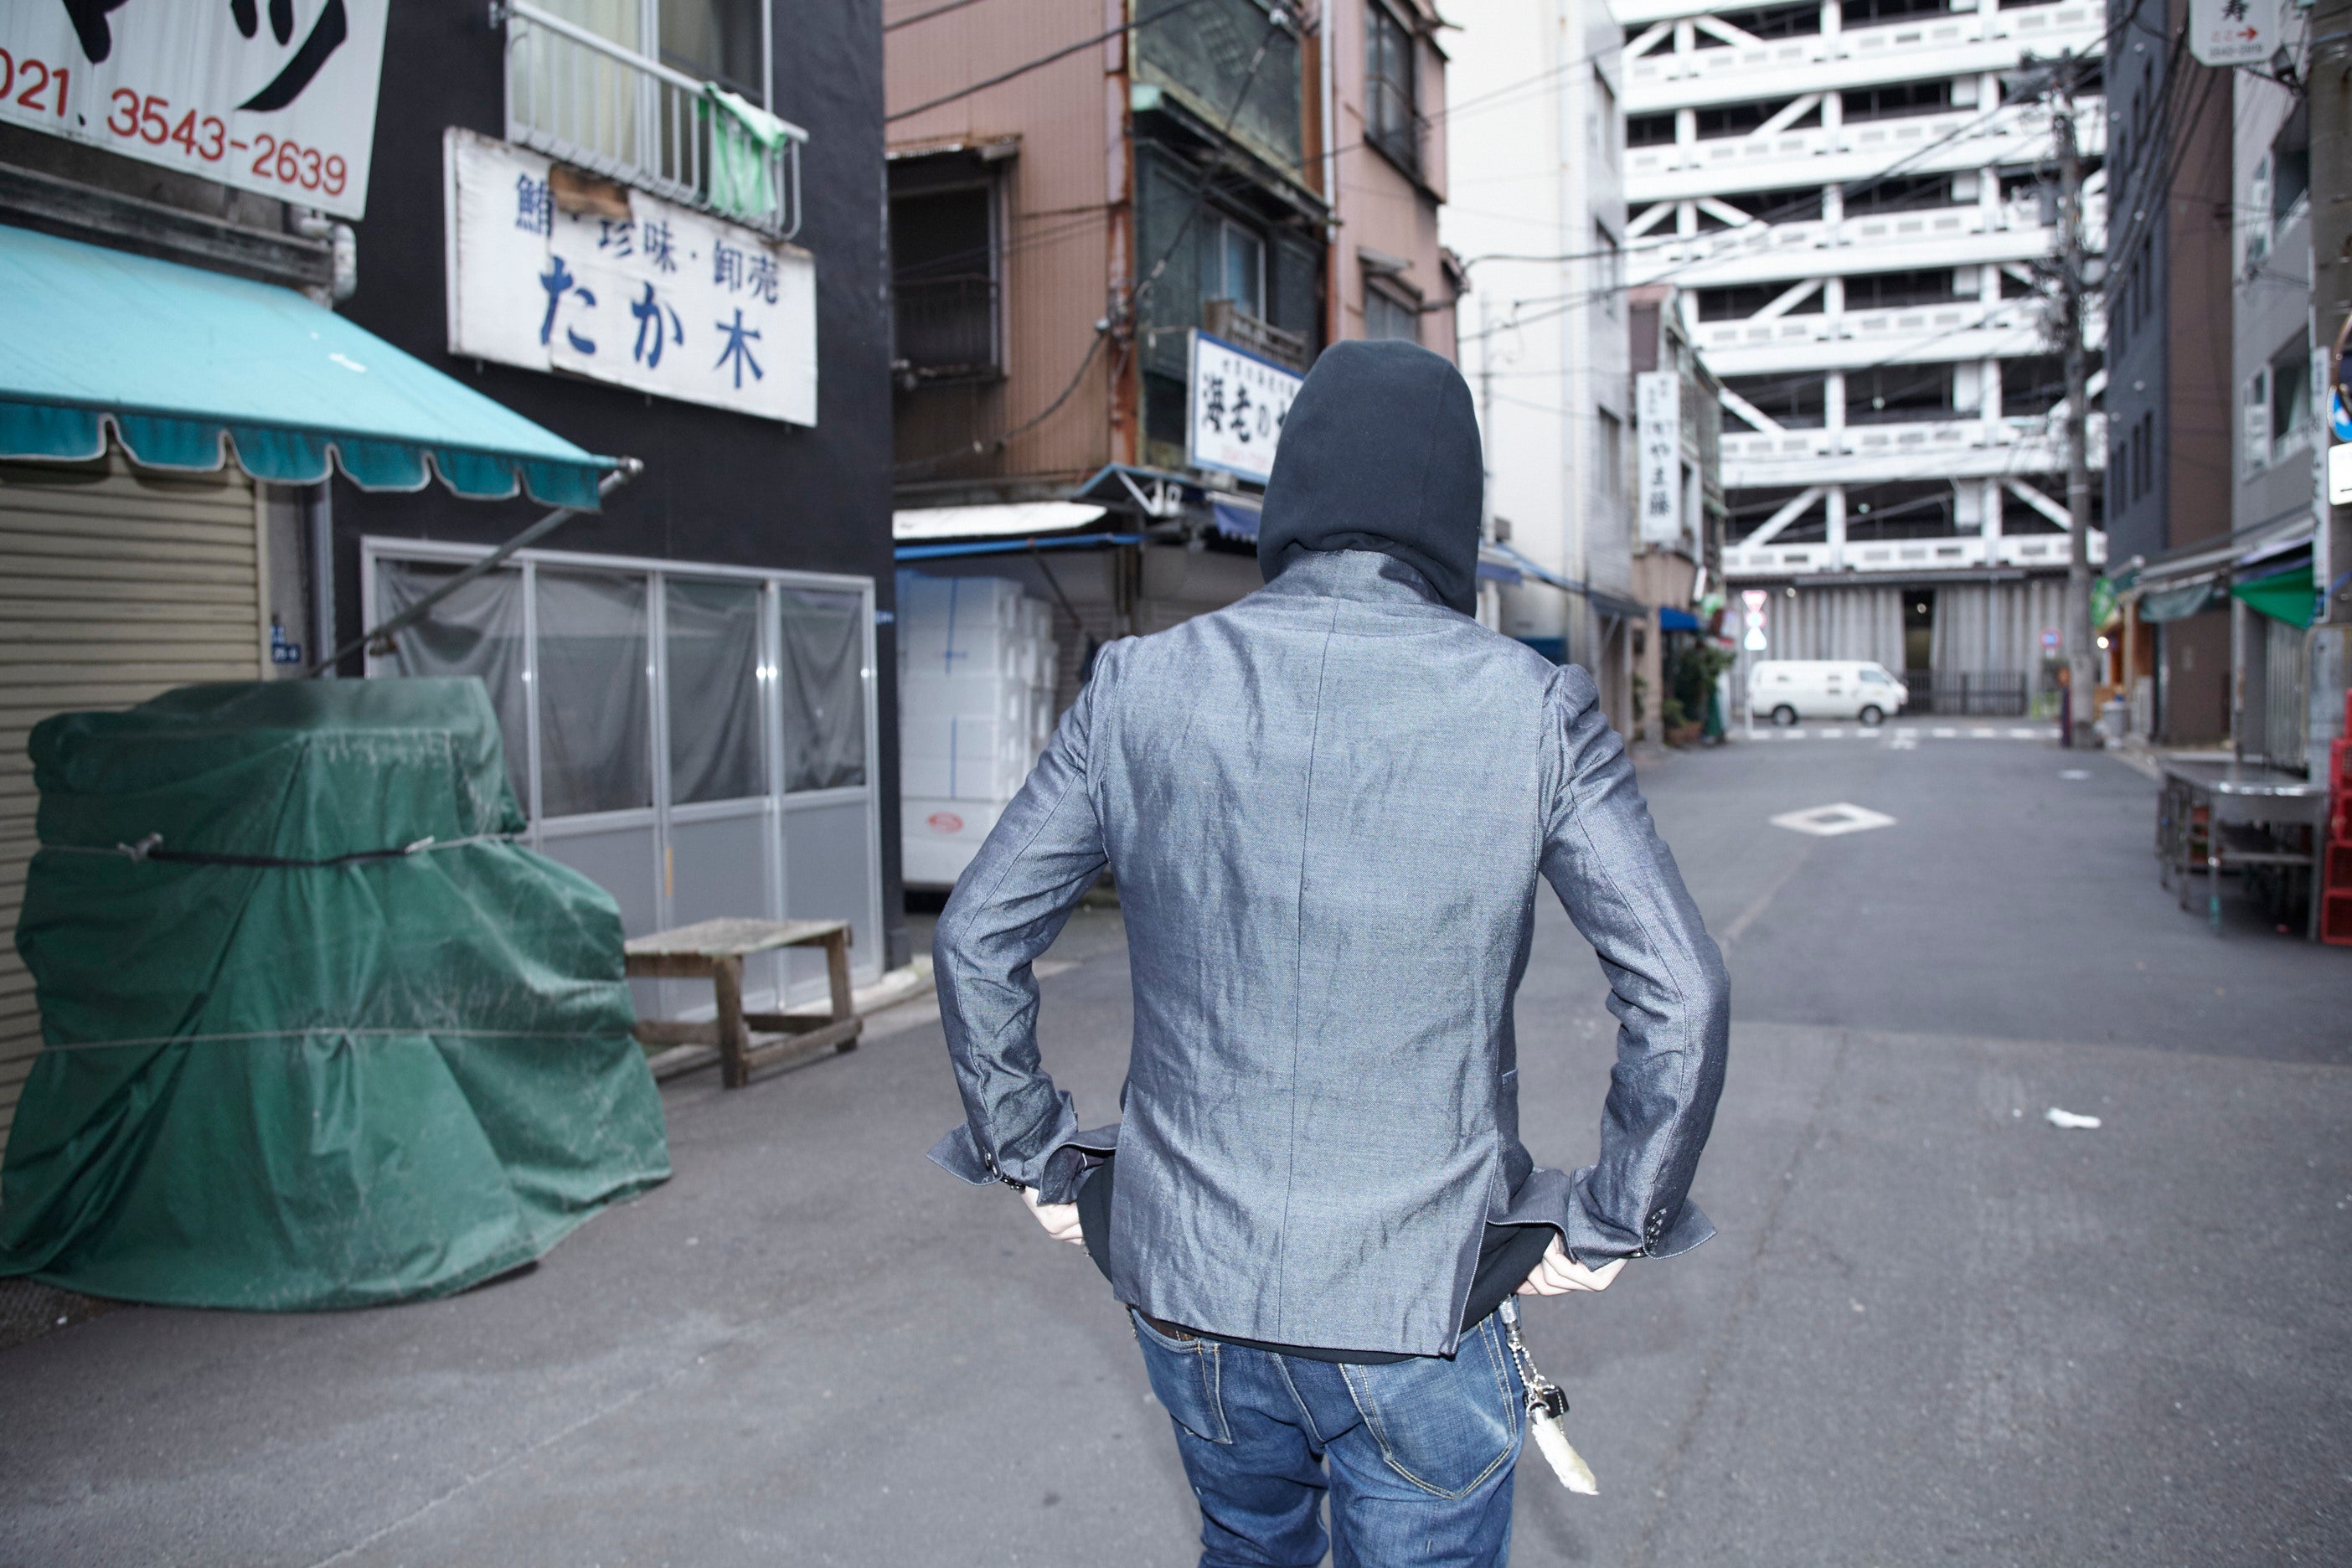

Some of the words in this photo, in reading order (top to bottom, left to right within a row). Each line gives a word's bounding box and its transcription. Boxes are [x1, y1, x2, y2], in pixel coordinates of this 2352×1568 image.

[107, 88, 347, 197] 3543-2639
[540, 255, 763, 389] たか木
